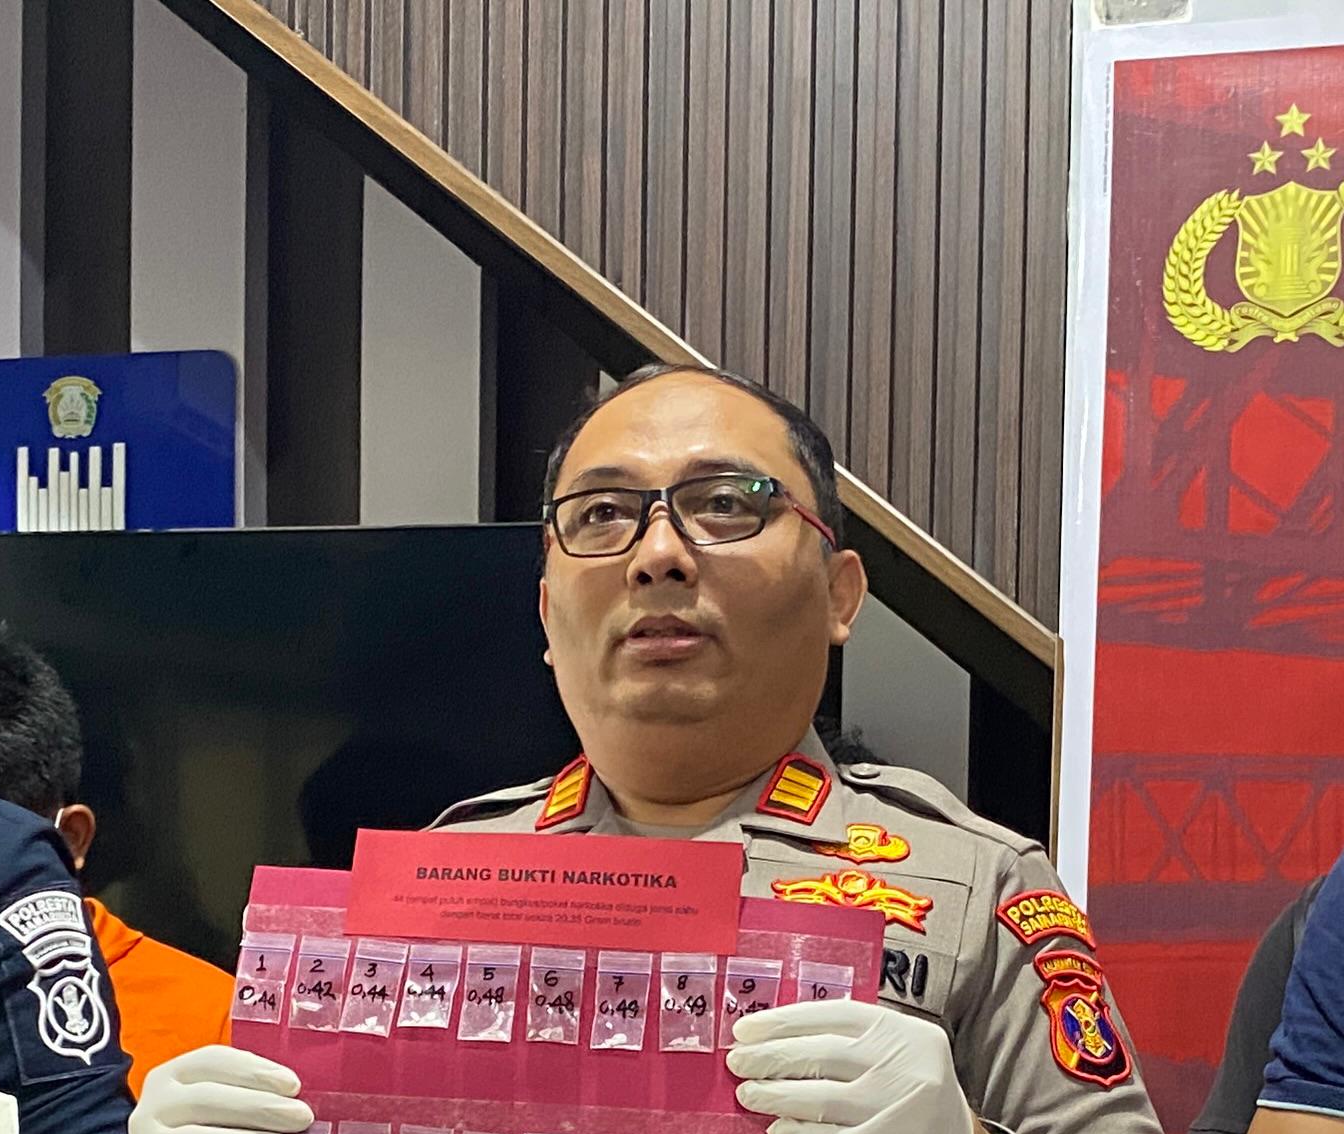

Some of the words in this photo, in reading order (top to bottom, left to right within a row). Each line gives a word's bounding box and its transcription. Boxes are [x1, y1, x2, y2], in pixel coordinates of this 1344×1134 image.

[416, 866, 492, 882] BARANG
[498, 868, 556, 885] BUKTI
[563, 869, 678, 889] NARKOTIKA
[8, 898, 77, 928] POLRESTA
[256, 954, 267, 972] 1
[309, 959, 325, 973] 2
[364, 963, 377, 978] 3
[420, 963, 434, 982] 4
[483, 967, 497, 981] 5
[544, 970, 560, 987] 6
[612, 975, 625, 992] 7
[677, 975, 689, 990] 8
[739, 978, 756, 994] 9
[811, 983, 828, 1000] 10
